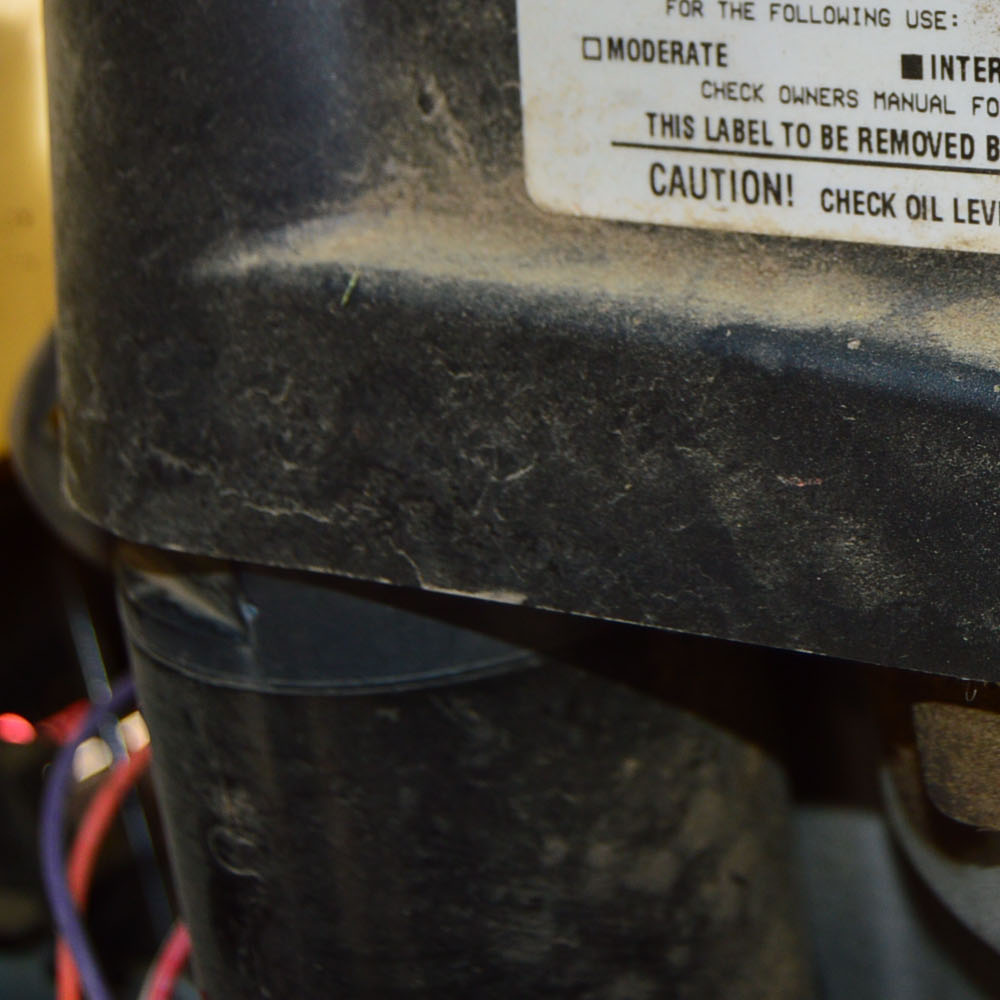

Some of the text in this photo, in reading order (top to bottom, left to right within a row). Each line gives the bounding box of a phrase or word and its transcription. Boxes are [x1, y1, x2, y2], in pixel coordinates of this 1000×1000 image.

[718, 0, 755, 21] THE
[769, 2, 891, 28] FOLLOWING
[905, 9, 958, 31] USE:
[606, 36, 728, 68] MODERATE
[701, 79, 764, 103] CHECK
[779, 84, 859, 109] OWNERS
[873, 91, 957, 115] MANUAL
[645, 111, 695, 141] THIS
[704, 116, 774, 147] LABEL
[780, 121, 812, 149] TO
[820, 123, 849, 153] BE
[857, 126, 975, 161] REMOVED
[649, 161, 794, 207] CAUTION!
[820, 187, 897, 219] CHECK
[905, 193, 944, 223] OIL
